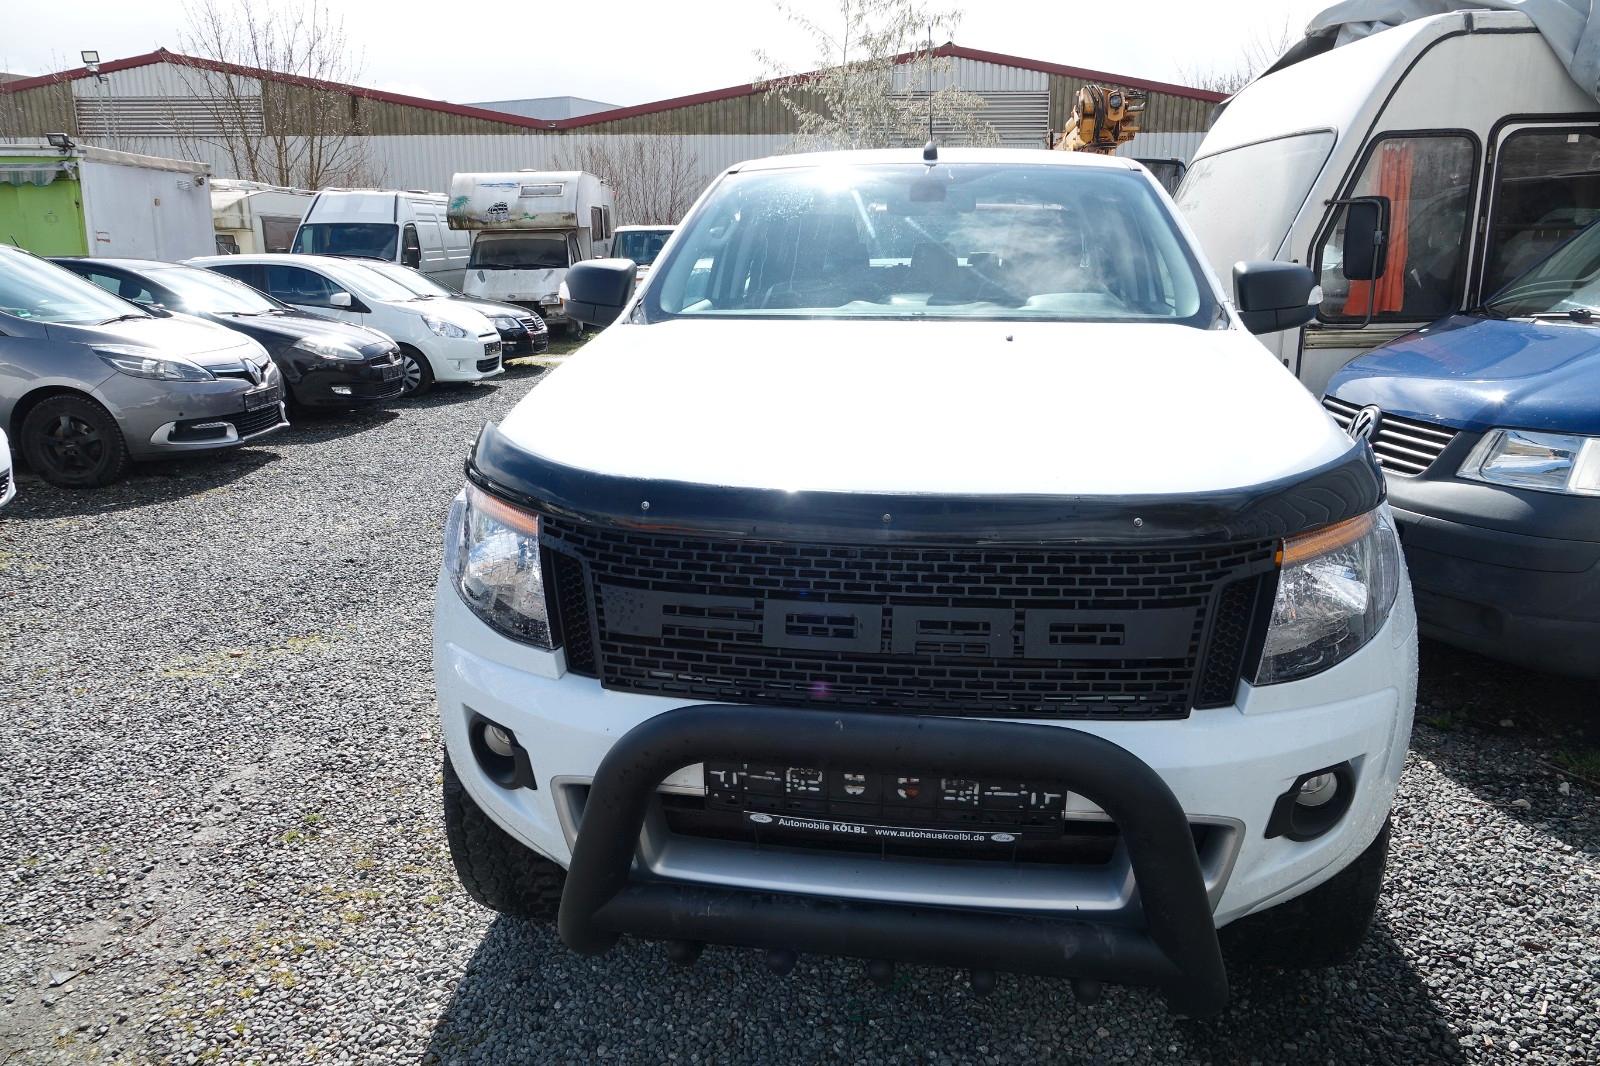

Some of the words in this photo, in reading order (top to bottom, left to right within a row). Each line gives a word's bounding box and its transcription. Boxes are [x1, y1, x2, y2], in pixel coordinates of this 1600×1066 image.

[601, 588, 1198, 660] FORD
[778, 818, 830, 831] Automobile
[832, 822, 868, 834] KÖLBL
[875, 828, 985, 842] www.autohauskoelbl.de
